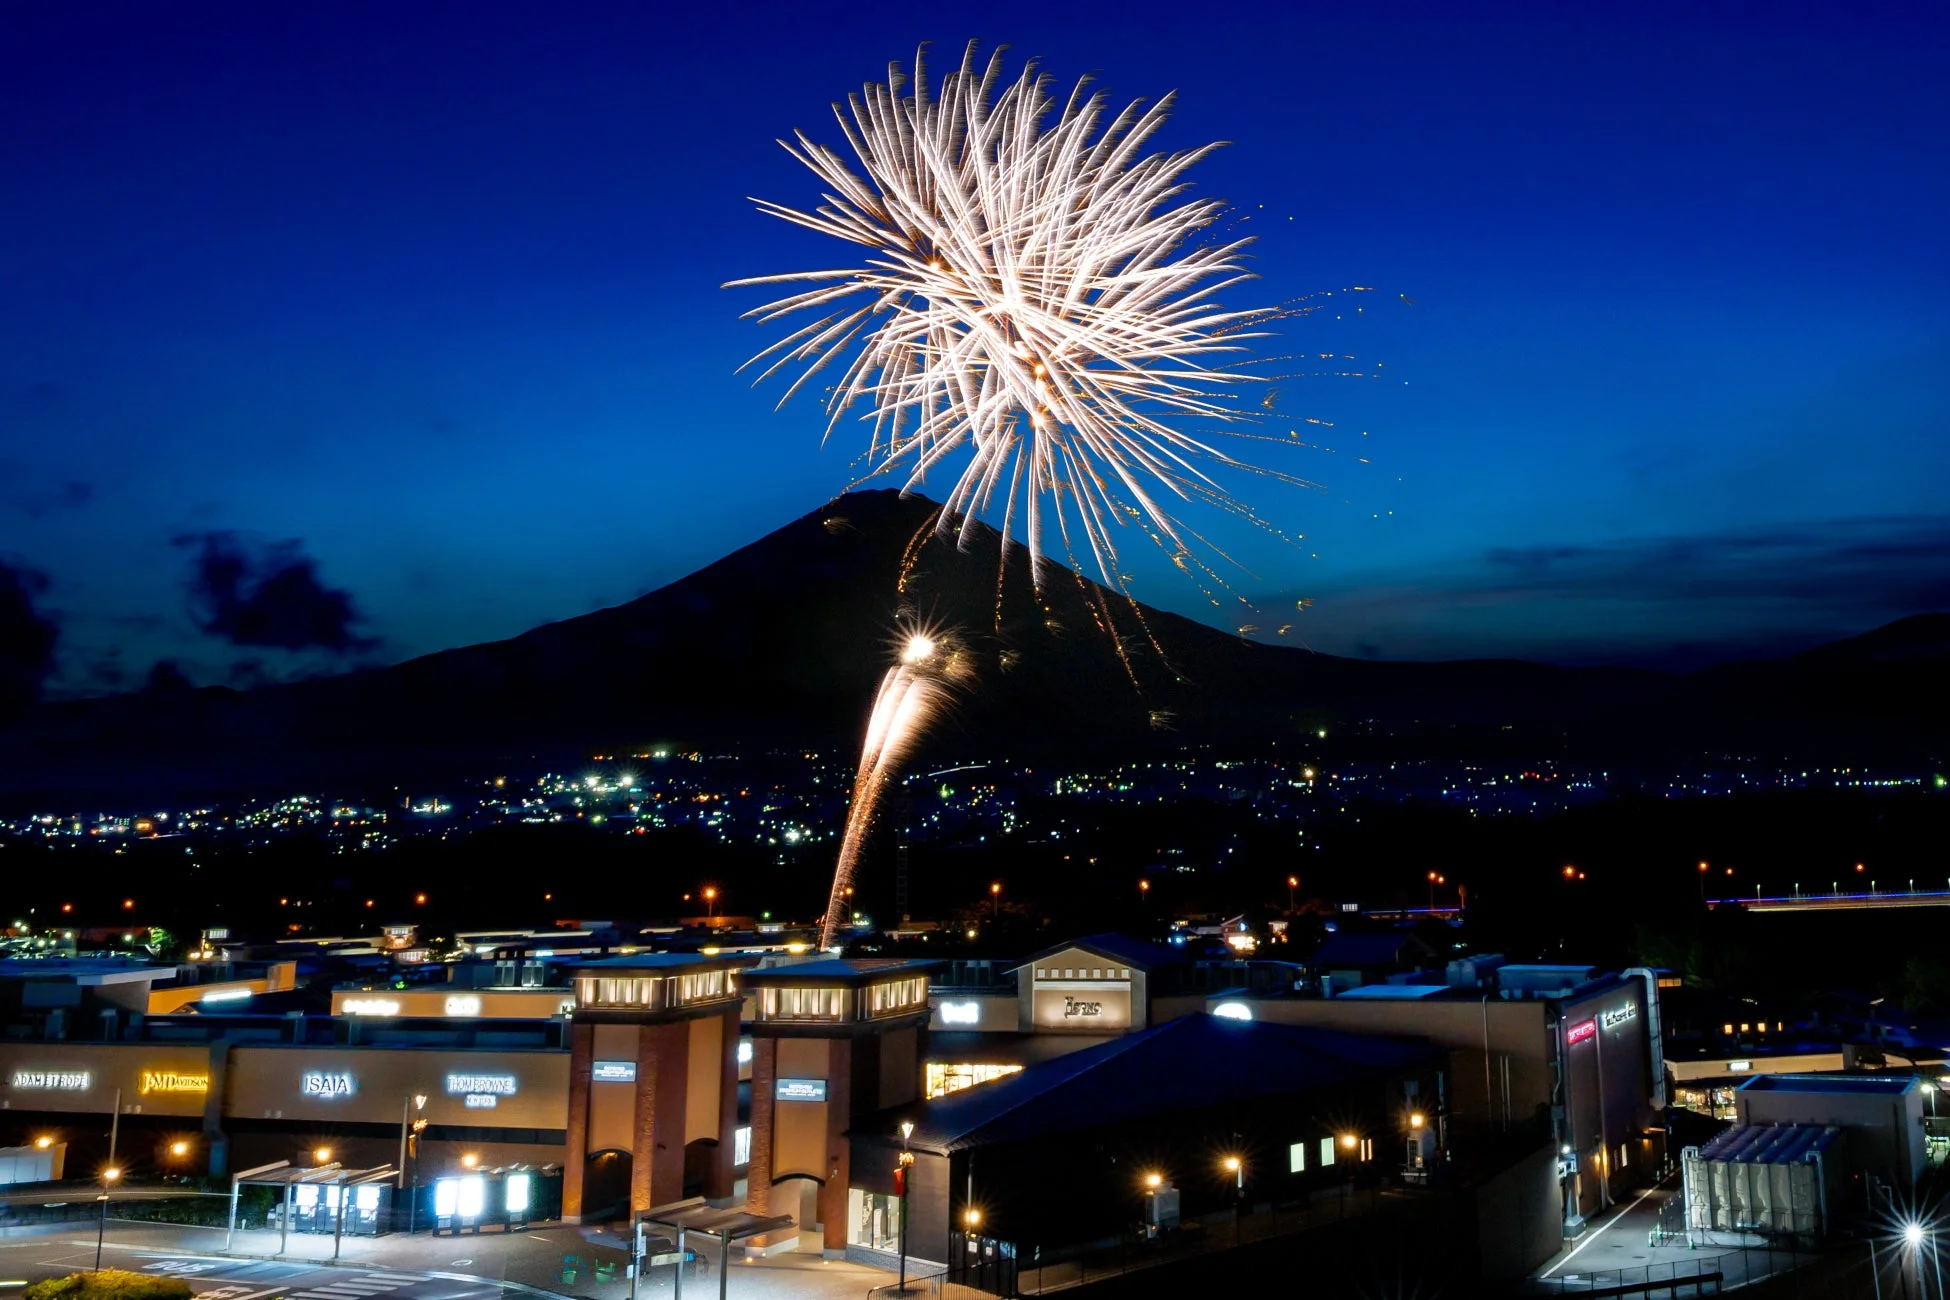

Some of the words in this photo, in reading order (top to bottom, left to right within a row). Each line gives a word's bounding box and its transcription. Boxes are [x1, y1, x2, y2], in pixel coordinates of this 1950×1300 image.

[13, 1073, 41, 1088] ADAM
[43, 1073, 56, 1088] ET
[304, 1076, 348, 1093] ISAIA
[447, 1076, 473, 1091] THOM
[141, 1261, 216, 1273] BUS
